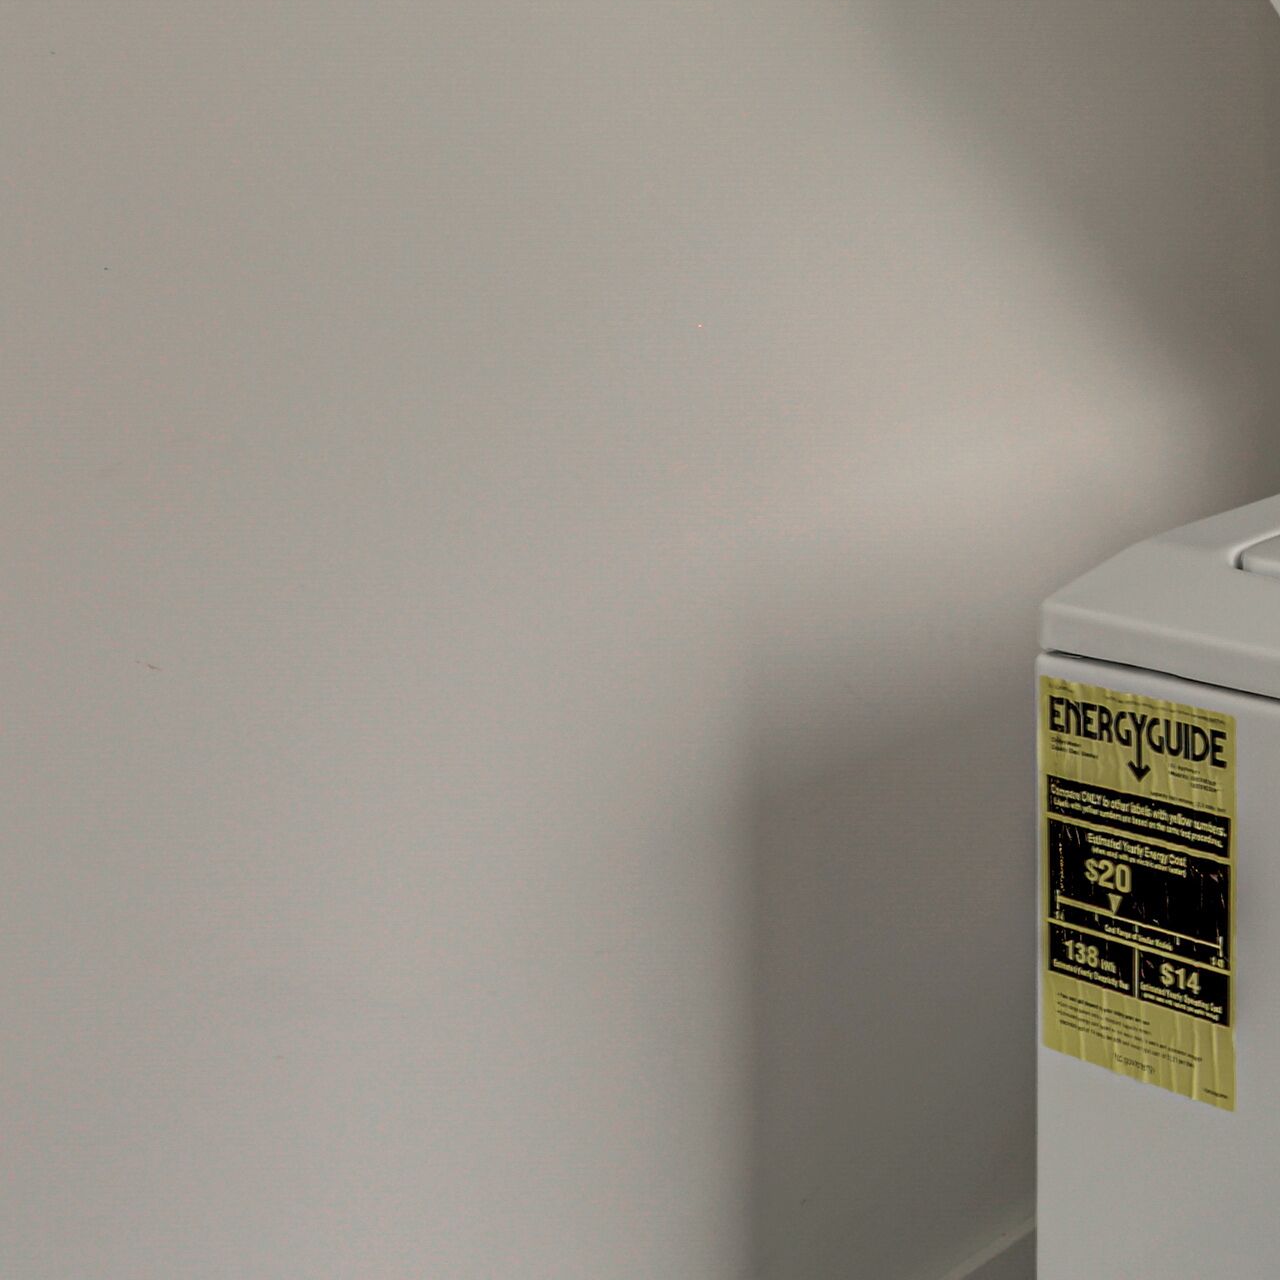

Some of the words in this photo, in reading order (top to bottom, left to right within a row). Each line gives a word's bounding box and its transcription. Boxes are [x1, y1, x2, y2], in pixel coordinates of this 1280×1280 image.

[1048, 694, 1228, 770] ENERGYGUIDE
[1050, 783, 1081, 801] Compare
[1081, 790, 1102, 806] ONLY
[1102, 796, 1110, 807] to
[1110, 798, 1129, 812] other
[1130, 801, 1152, 817] labels
[1152, 808, 1168, 821] with
[1169, 812, 1193, 828] yellow
[1087, 832, 1122, 850] Estimated
[1122, 840, 1144, 857] Yearly
[1144, 846, 1168, 865] Energy
[1168, 853, 1187, 867] Cost
[1084, 857, 1133, 894] $20
[1065, 939, 1100, 969] 138
[1159, 961, 1202, 996] $14
